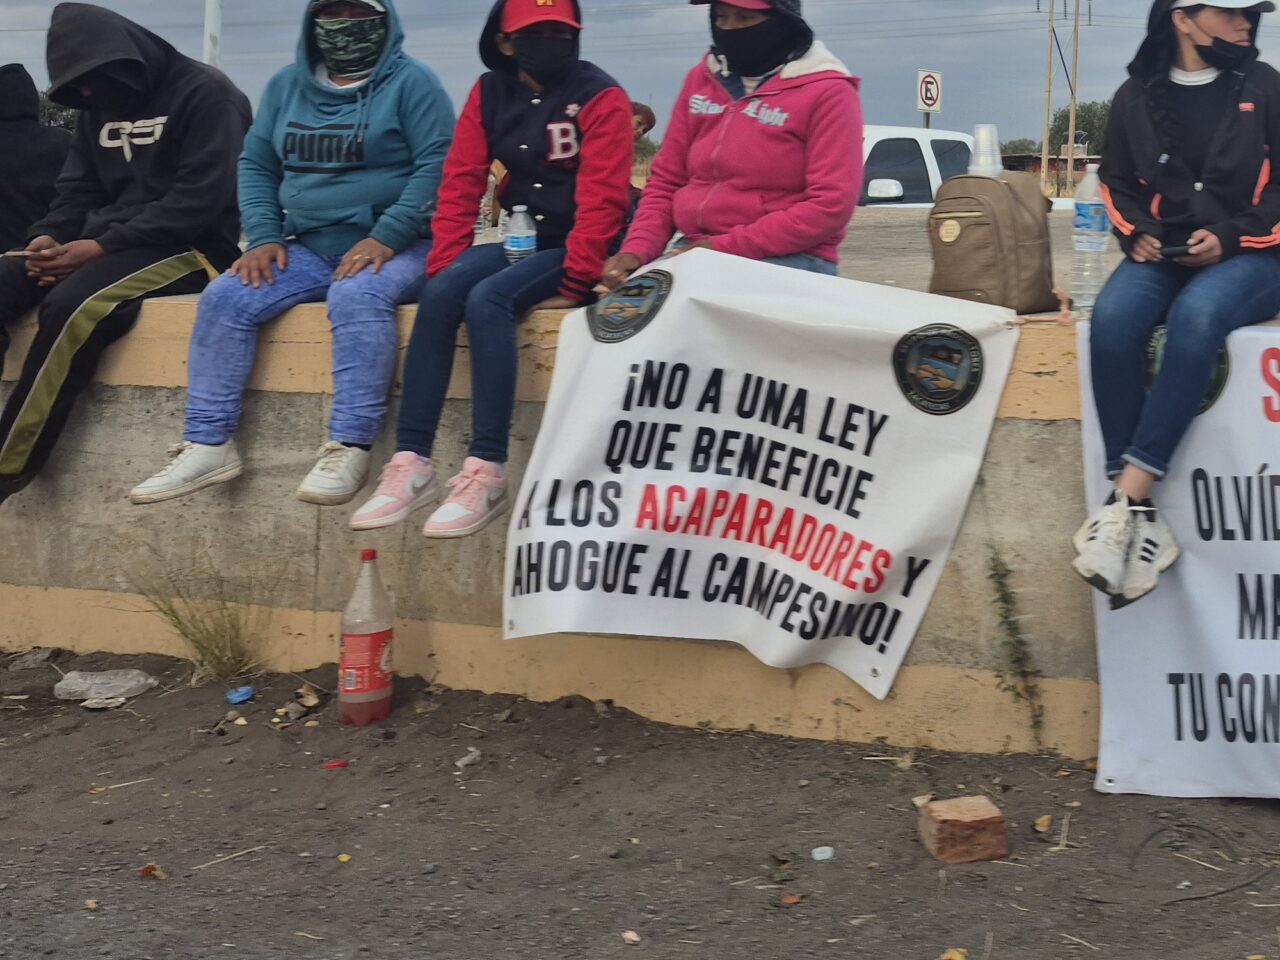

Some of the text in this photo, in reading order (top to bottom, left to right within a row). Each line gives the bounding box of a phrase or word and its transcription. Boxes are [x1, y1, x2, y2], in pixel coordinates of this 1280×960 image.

[283, 132, 365, 164] PUMA
[546, 121, 580, 160] B
[622, 360, 889, 456] ¡NO A UNA LEY
[605, 419, 875, 519] QUE BENEFICIE
[545, 479, 622, 528] LOS
[635, 483, 892, 593] ACAPARADORES
[902, 555, 931, 598] Y
[511, 539, 903, 655] AHOGUE AL CAMPESINO!
[1166, 672, 1209, 742] TU
